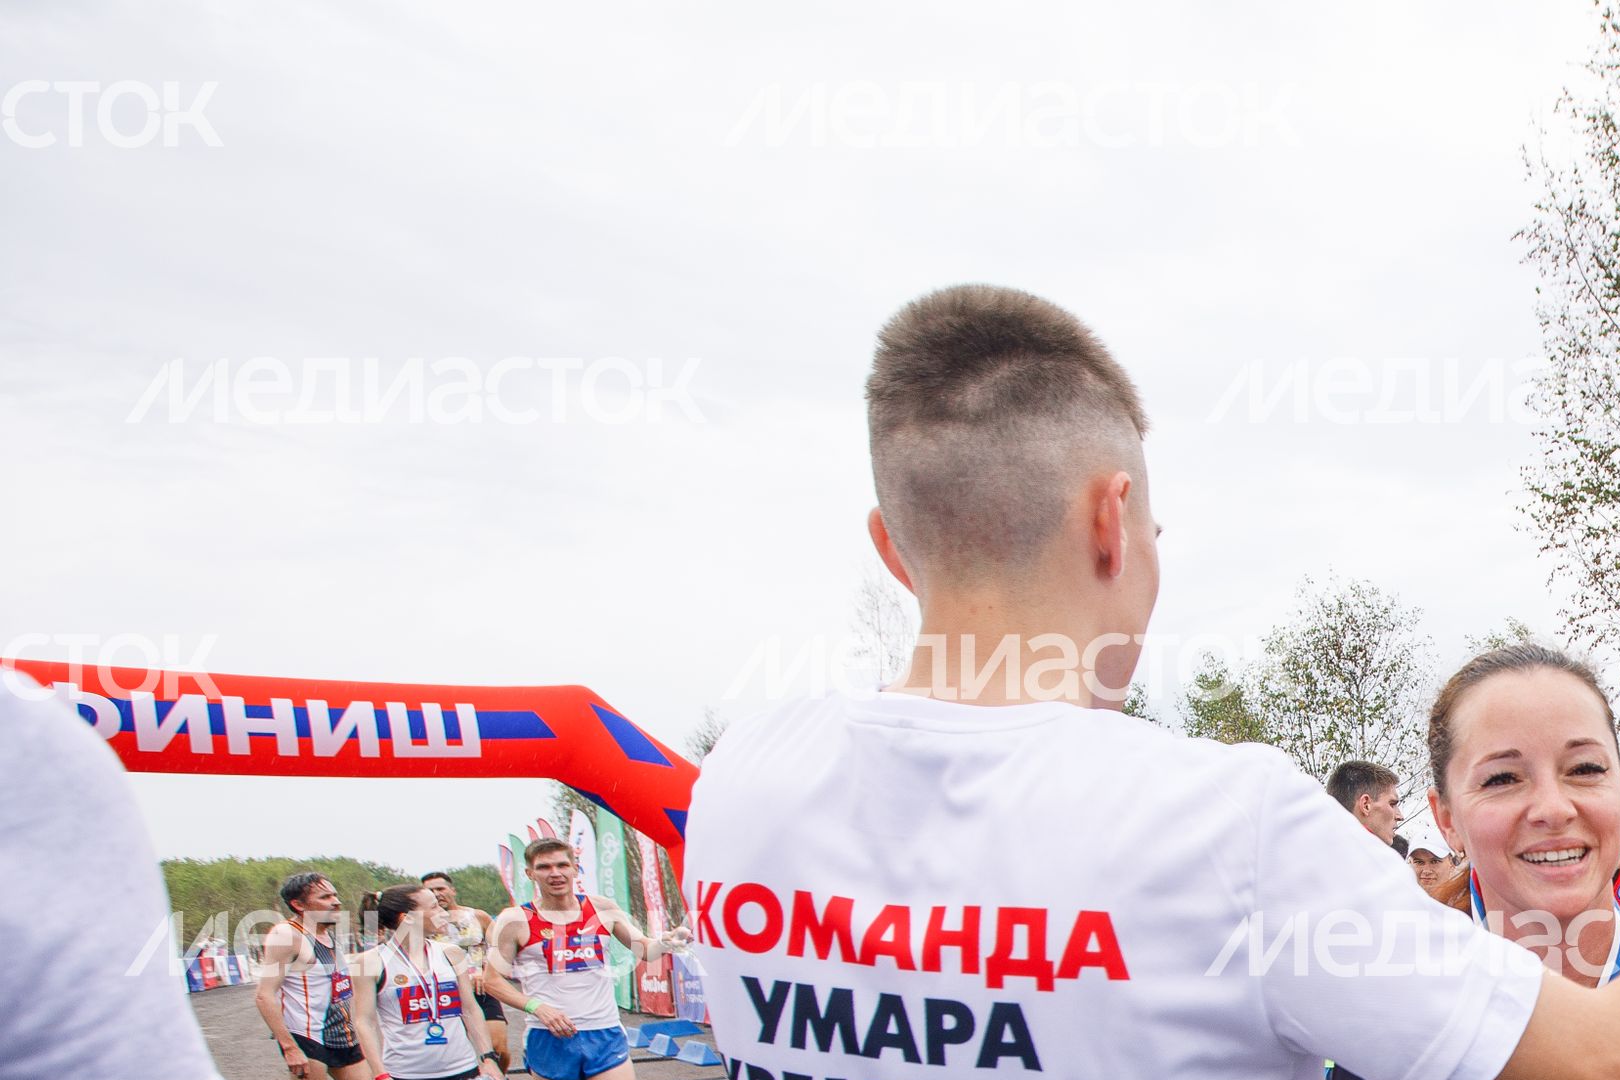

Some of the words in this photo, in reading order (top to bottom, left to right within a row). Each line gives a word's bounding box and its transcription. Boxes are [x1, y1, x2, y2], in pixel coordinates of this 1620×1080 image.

[553, 946, 596, 962] 7940
[697, 880, 1130, 992] КОМАНДА
[408, 994, 452, 1011] 589
[740, 976, 1043, 1072] УМАРА
